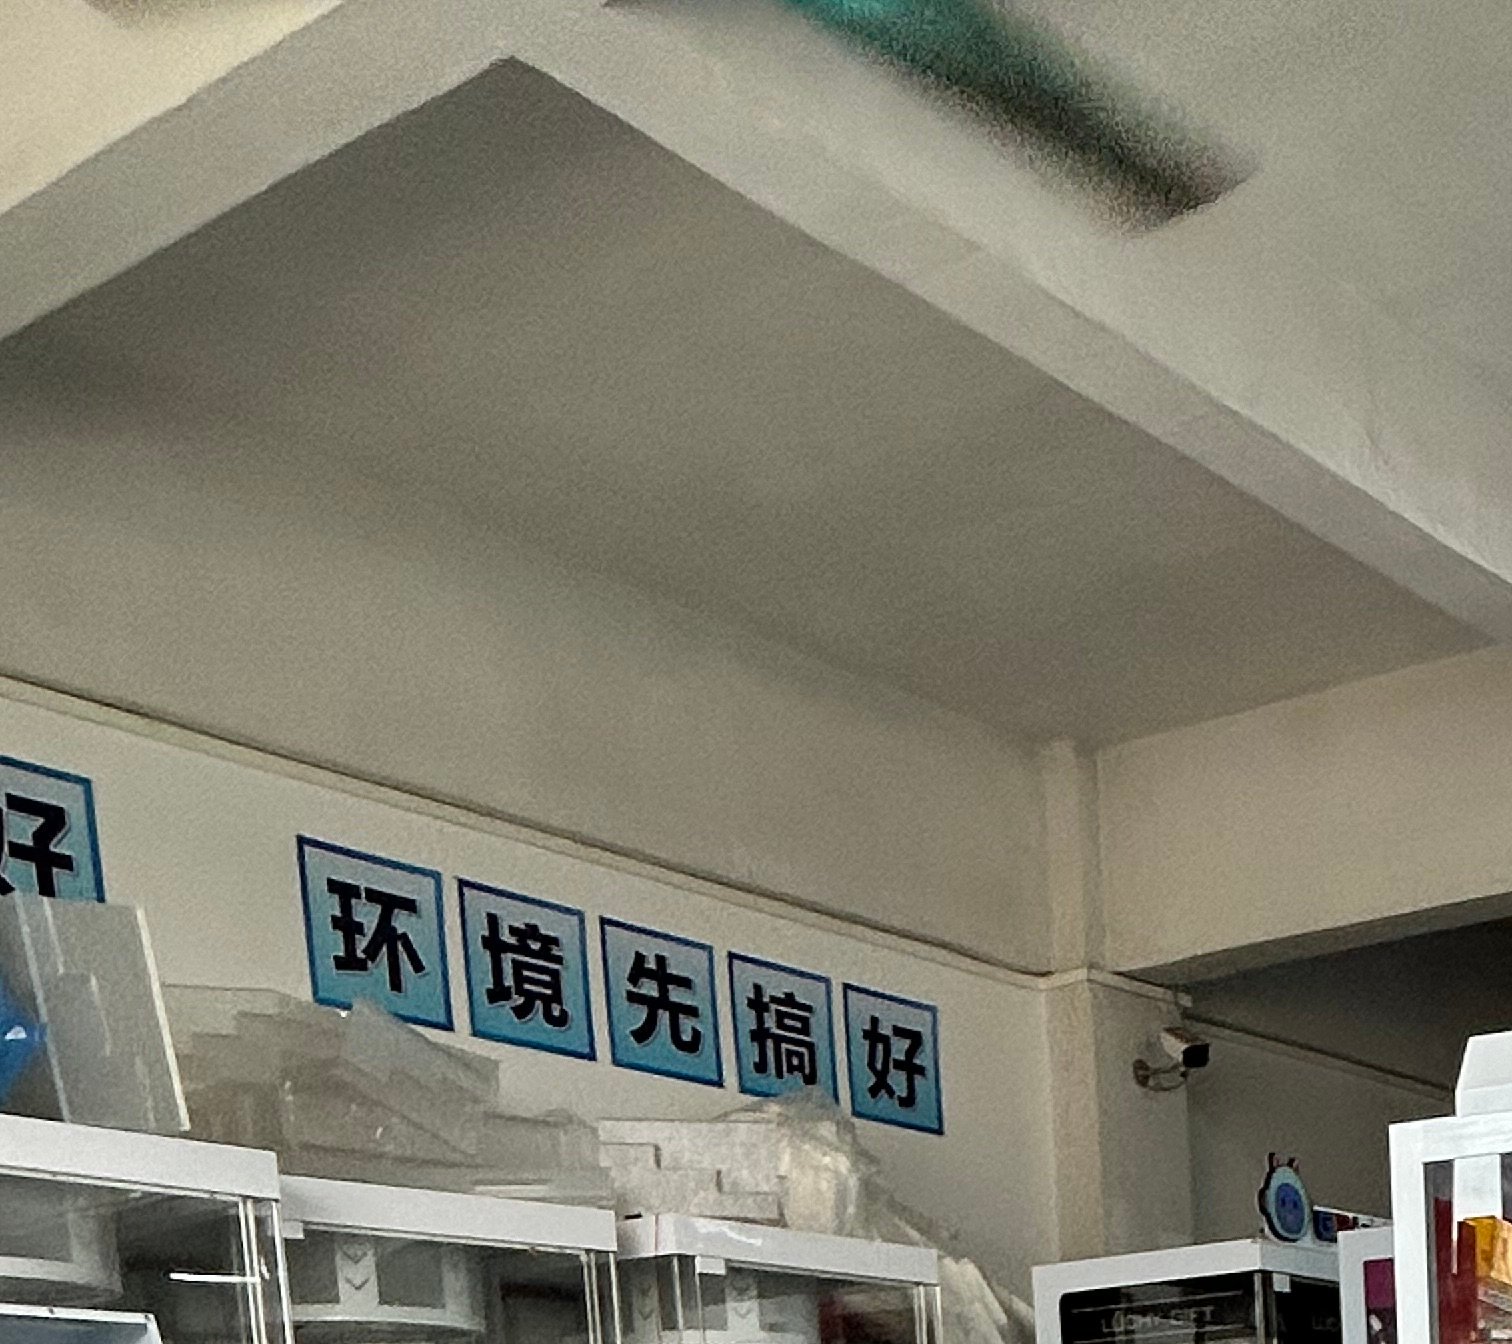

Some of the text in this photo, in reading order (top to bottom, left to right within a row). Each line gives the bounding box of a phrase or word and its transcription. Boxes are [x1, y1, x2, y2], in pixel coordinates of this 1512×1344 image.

[326, 877, 928, 1109] 环境先搞好
